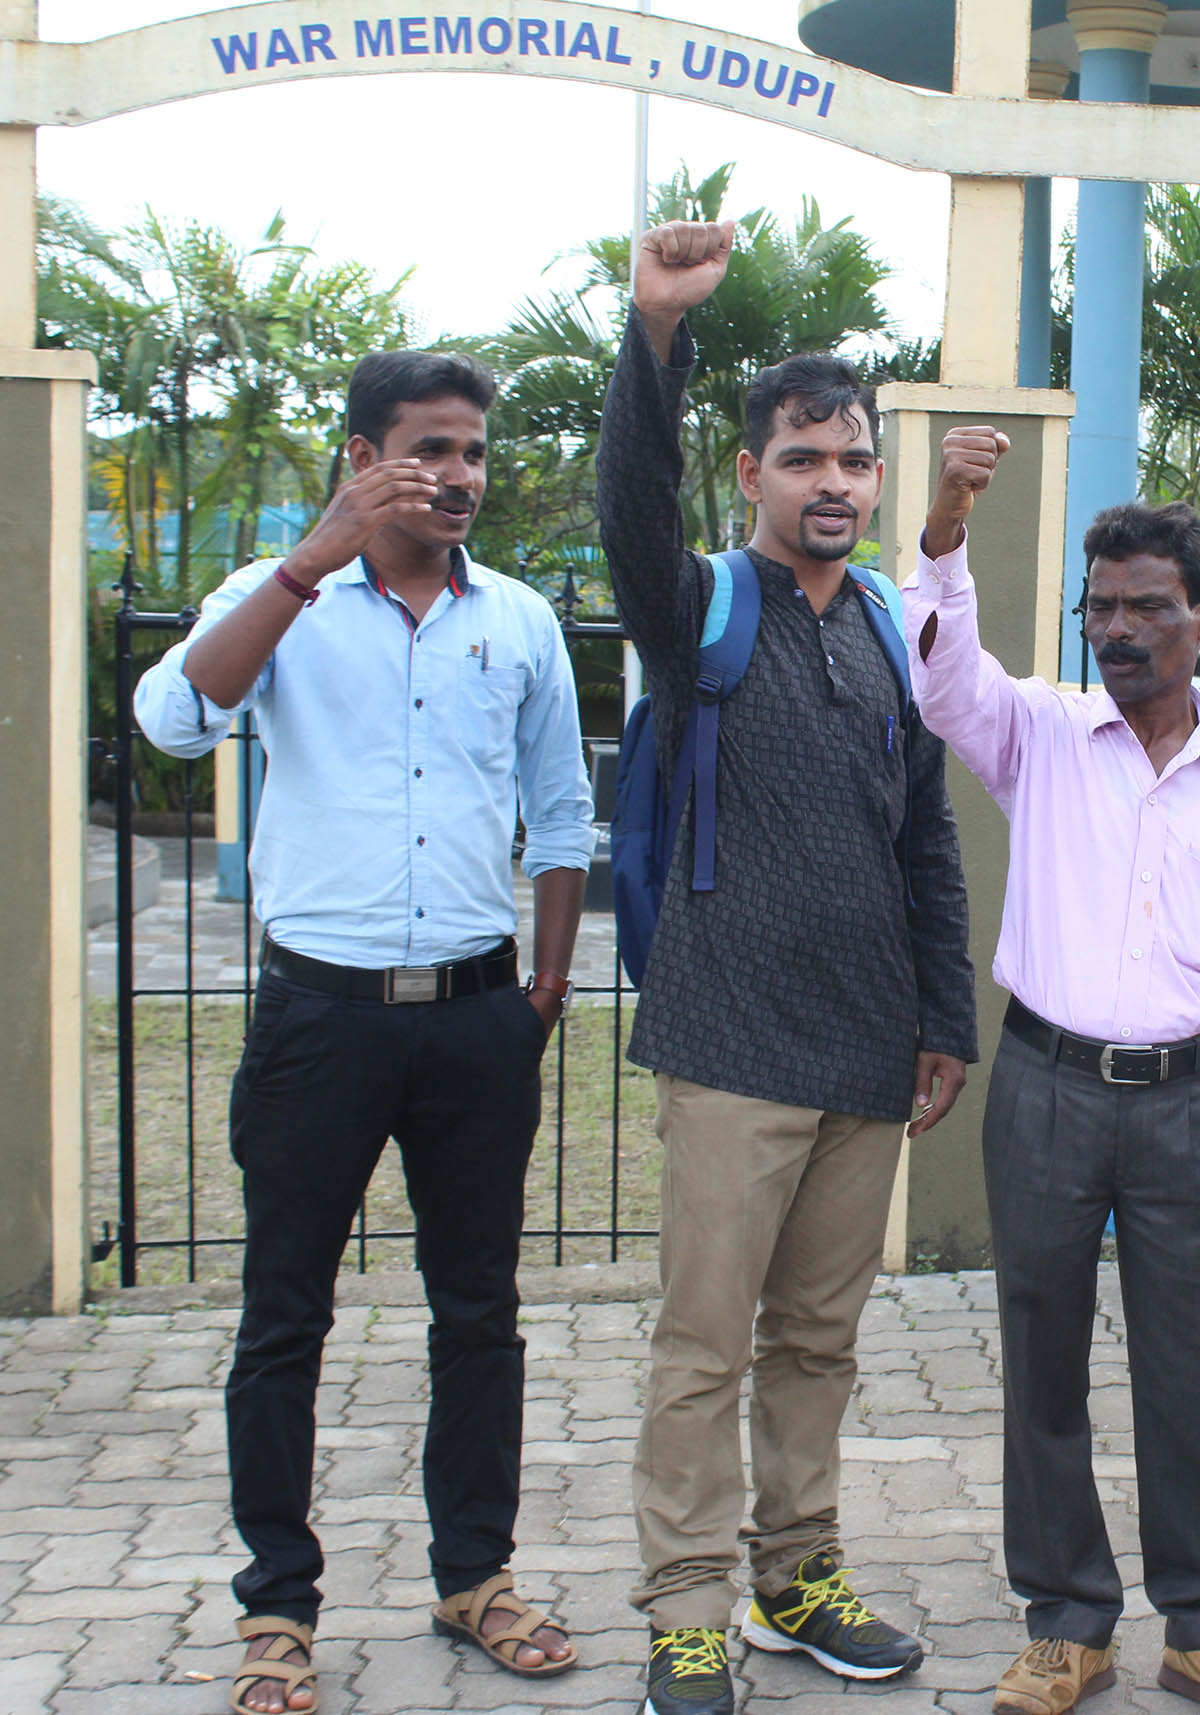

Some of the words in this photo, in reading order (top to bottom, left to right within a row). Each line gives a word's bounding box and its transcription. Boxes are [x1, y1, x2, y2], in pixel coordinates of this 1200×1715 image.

[211, 23, 336, 74] WAR
[354, 16, 632, 65] MEMORIAL
[682, 40, 835, 117] UDUPI
